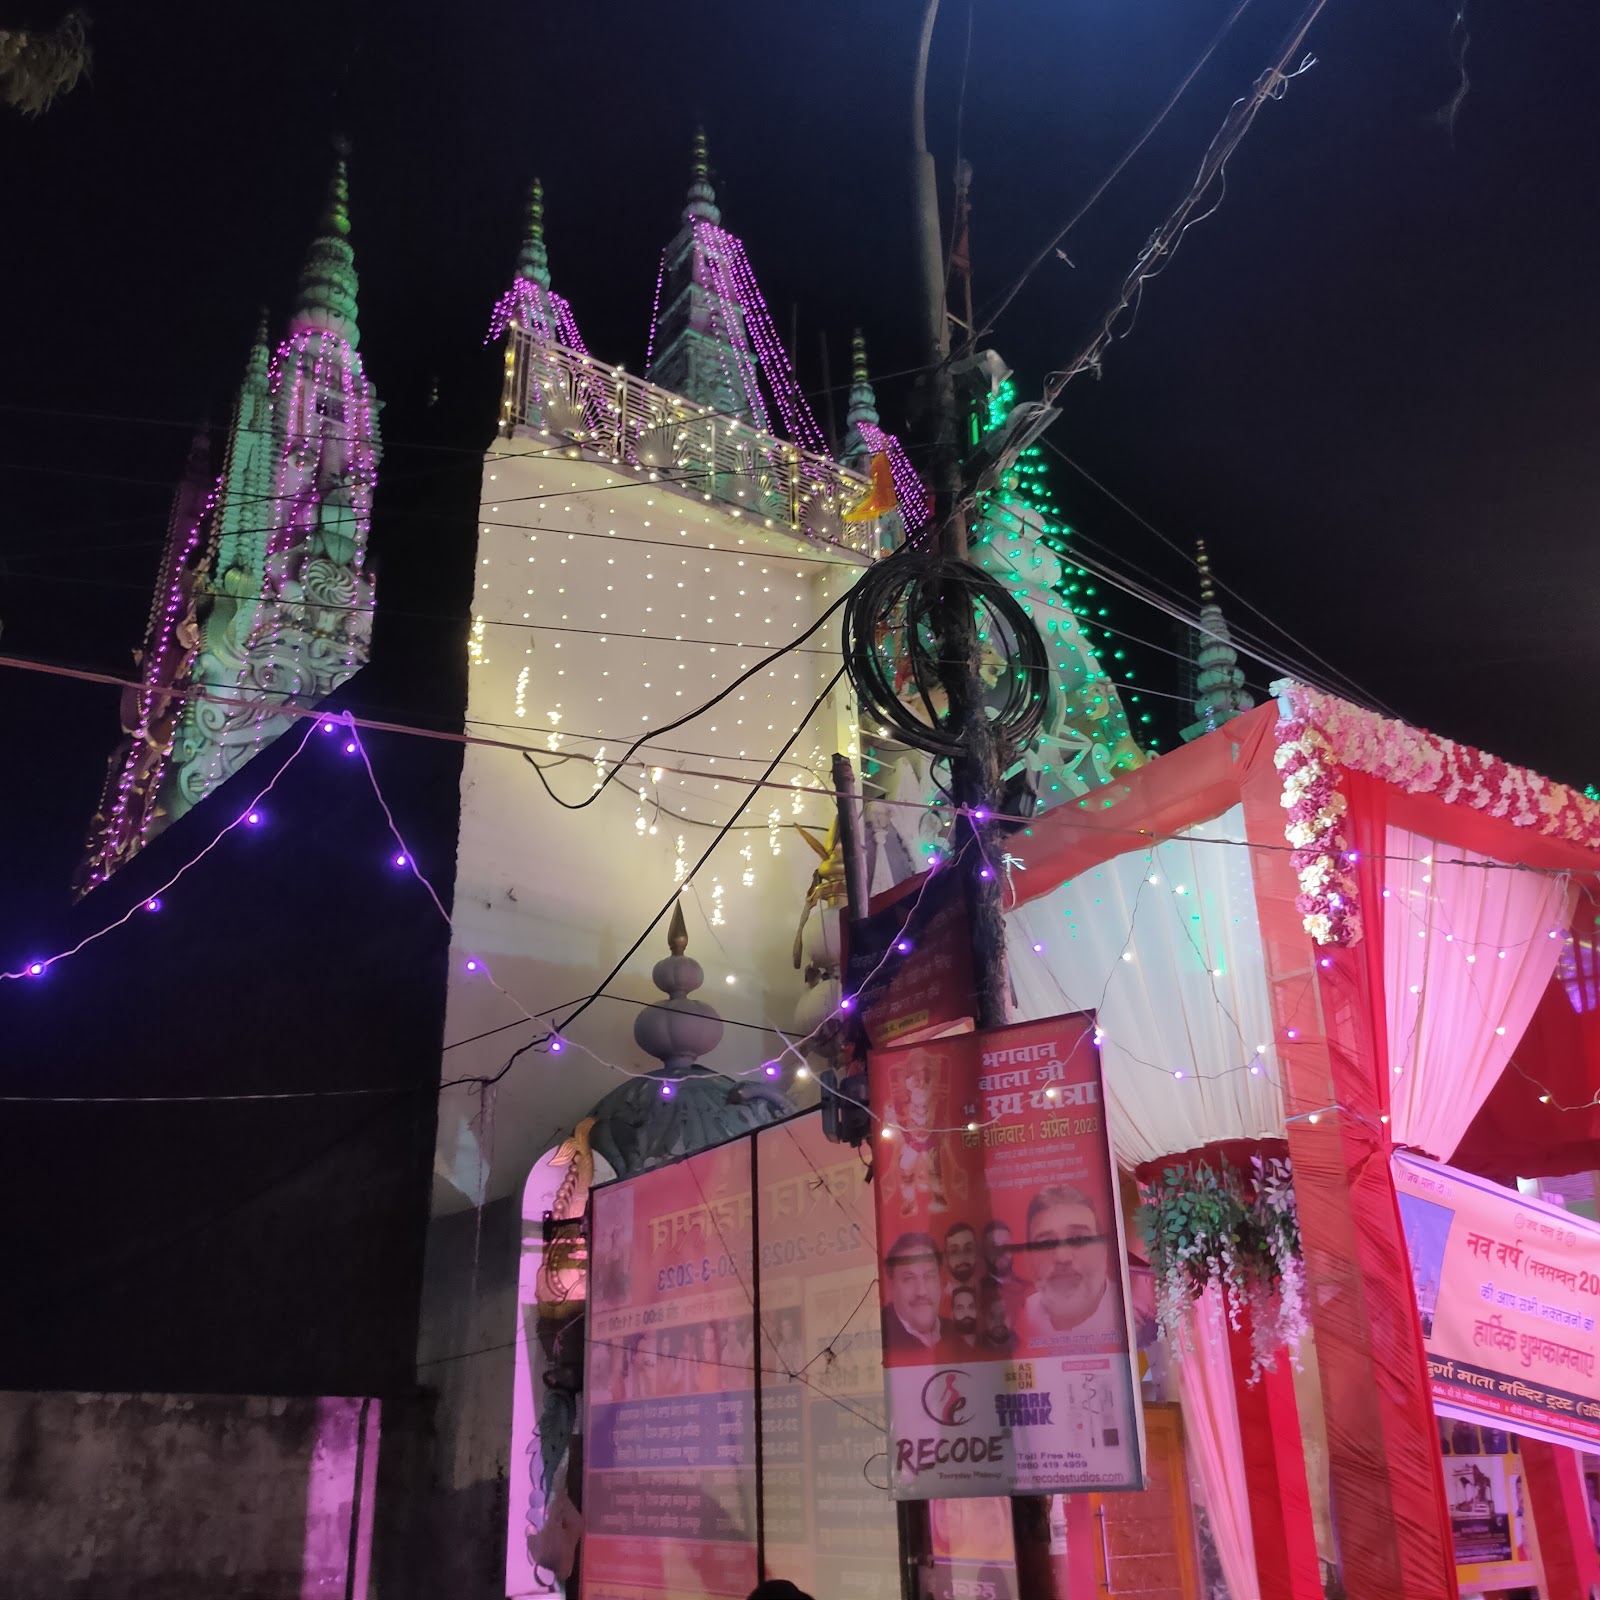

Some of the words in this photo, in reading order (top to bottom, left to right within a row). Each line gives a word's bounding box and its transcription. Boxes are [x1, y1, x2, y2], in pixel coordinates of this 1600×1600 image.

[983, 1042, 1057, 1068] भगवान
[978, 1069, 1031, 1091] बाला
[1035, 1060, 1065, 1080] जी
[986, 1092, 1024, 1118] रथ
[1029, 1081, 1097, 1110] यात्रा
[984, 1120, 1026, 1147] शनिवार
[1029, 1123, 1034, 1140] 1
[1040, 1111, 1071, 1139] अप्रैल
[1074, 1117, 1099, 1135] 2023
[1467, 1232, 1495, 1263] नव
[1497, 1239, 1523, 1270] वर्ष
[1578, 1271, 1600, 1297] 20
[1481, 1283, 1493, 1300] की
[1497, 1291, 1516, 1308] आप
[1473, 1314, 1517, 1352] हार्दिक
[1005, 1372, 1031, 1381] SEEN
[1019, 1363, 1031, 1371] AS
[1019, 1381, 1032, 1389] ON
[1457, 1369, 1495, 1390] माता
[1499, 1381, 1544, 1404] मन्दिर
[1546, 1393, 1573, 1411] ट्रस्ट
[995, 1392, 1051, 1409] SHARK
[995, 1407, 1055, 1426] TANK
[896, 1435, 1004, 1476] RECODE
